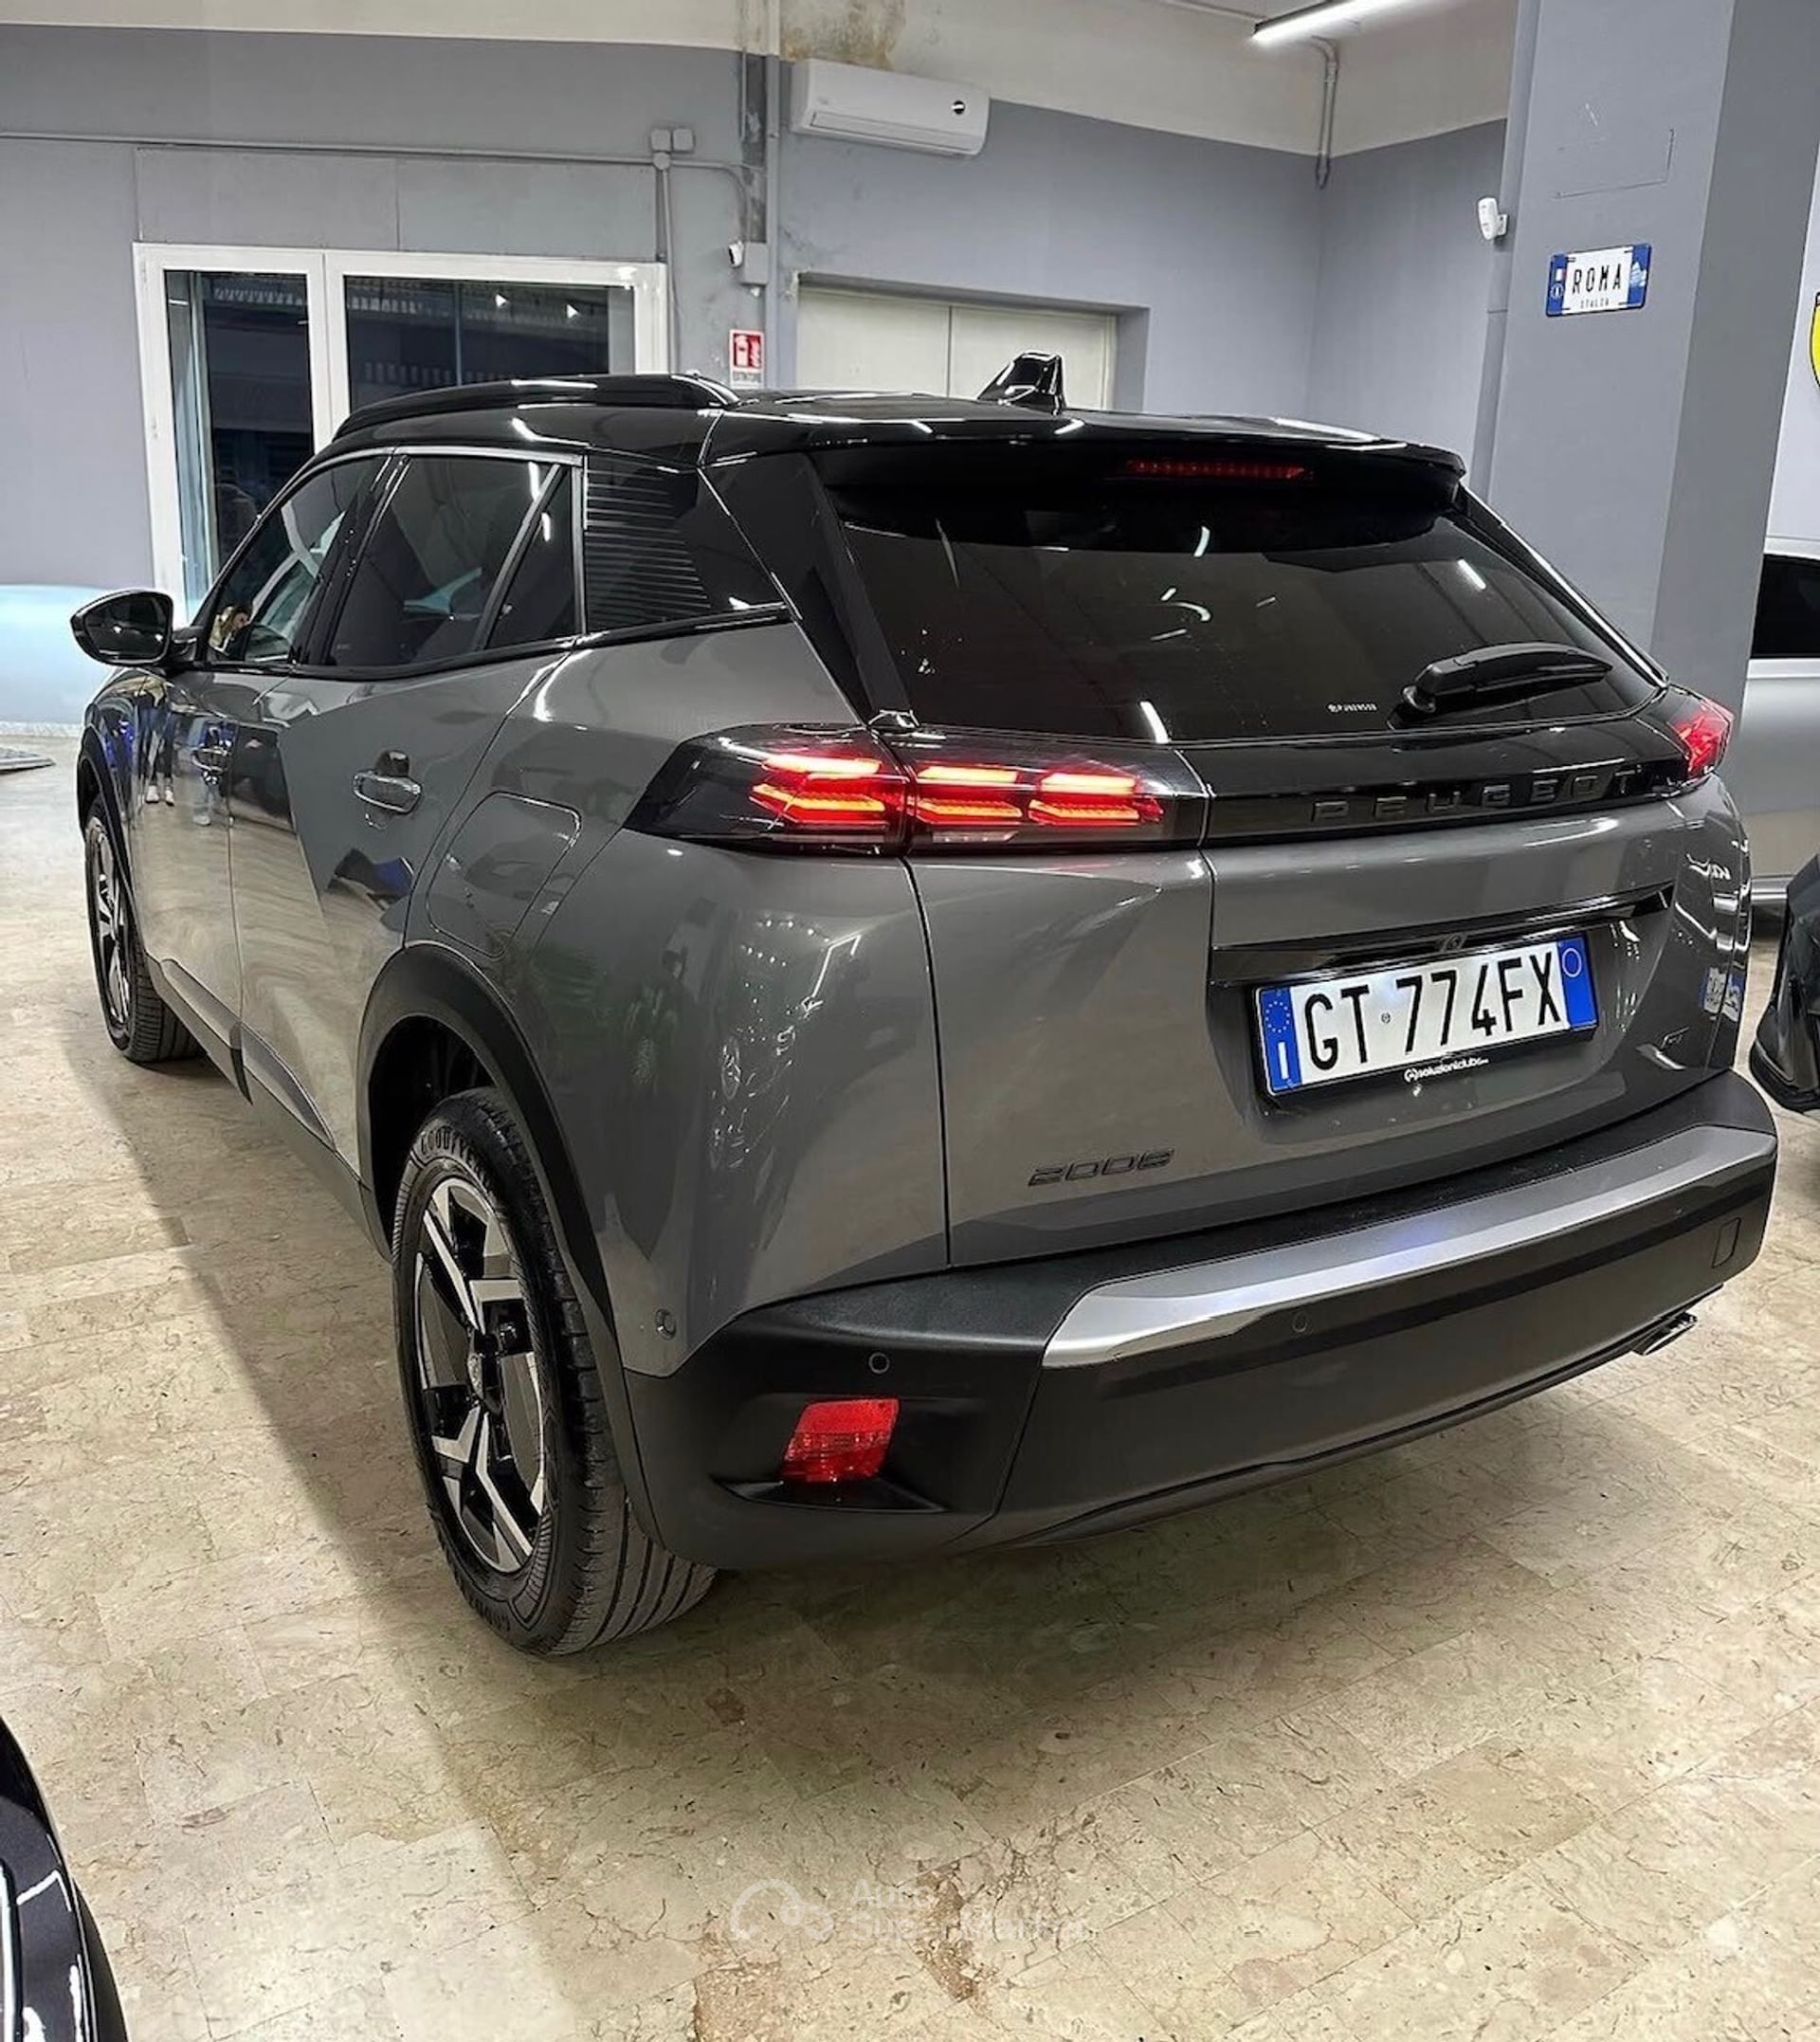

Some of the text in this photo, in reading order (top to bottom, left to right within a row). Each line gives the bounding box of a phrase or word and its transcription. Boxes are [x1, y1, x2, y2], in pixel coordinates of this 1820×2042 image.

[1573, 264, 1622, 295] ROMA
[1311, 765, 1641, 819] PEUGEOT
[1304, 951, 1561, 1070] GT 774FX
[1028, 1147, 1175, 1187] 2008
